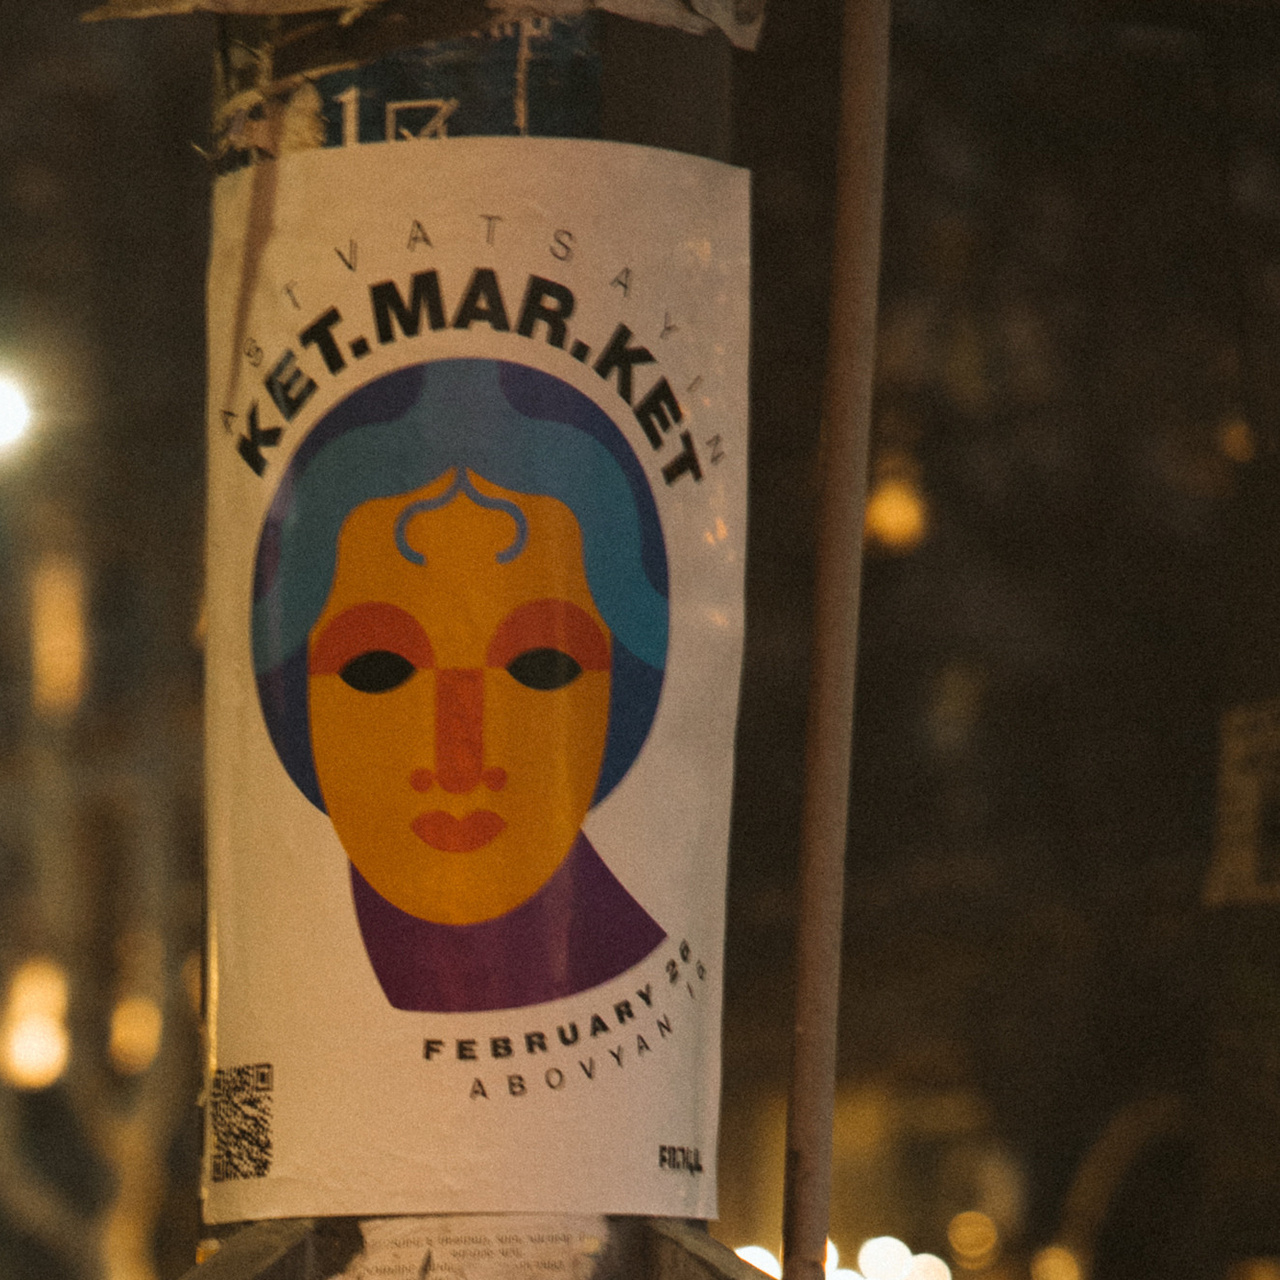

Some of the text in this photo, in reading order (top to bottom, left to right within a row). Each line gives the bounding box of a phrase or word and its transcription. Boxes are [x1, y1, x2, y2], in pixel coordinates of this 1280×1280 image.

[235, 267, 704, 487] KET.MAR.KET
[422, 982, 654, 1062] FEBRUARY
[468, 1013, 674, 1102] ABOVYAN
